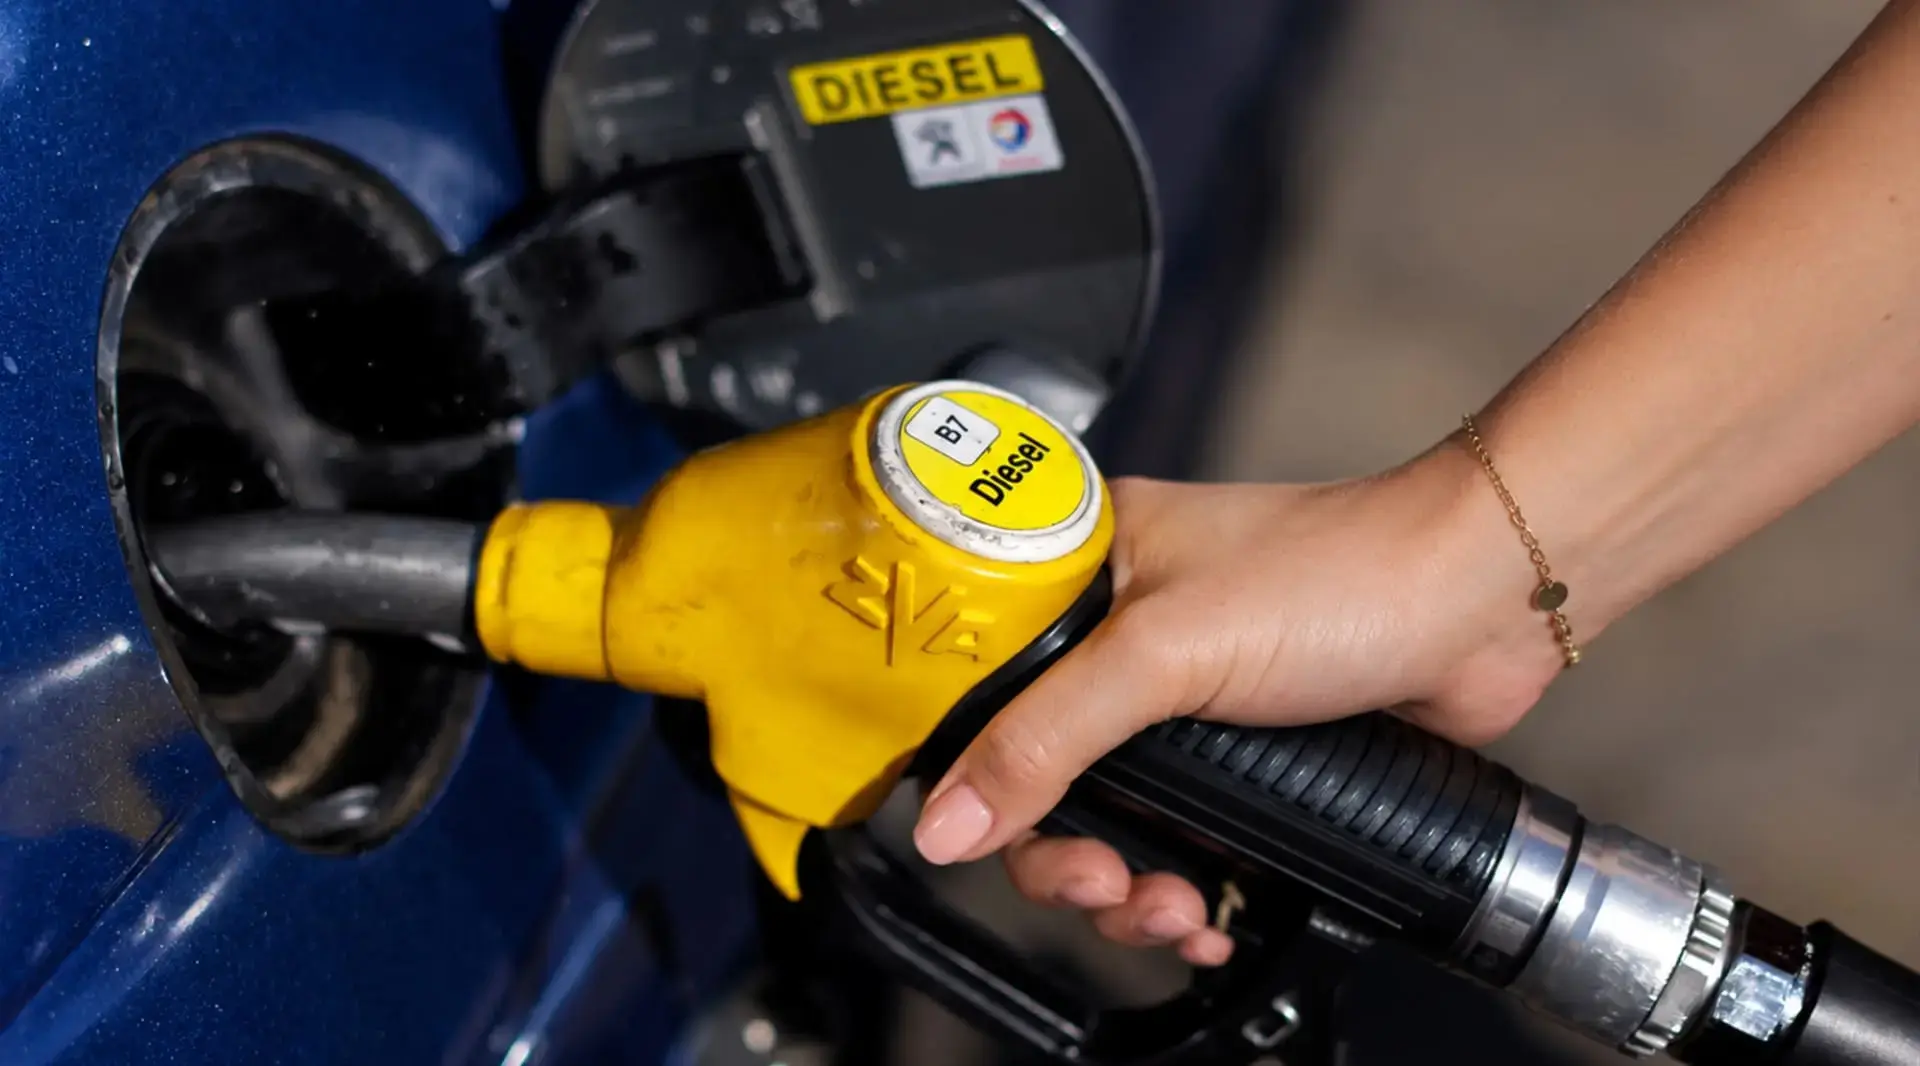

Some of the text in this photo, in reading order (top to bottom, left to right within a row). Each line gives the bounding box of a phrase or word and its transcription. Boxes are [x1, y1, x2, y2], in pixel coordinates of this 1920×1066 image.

[812, 52, 1021, 114] DIESEL
[934, 415, 968, 444] B7
[969, 432, 1050, 507] Diesel
